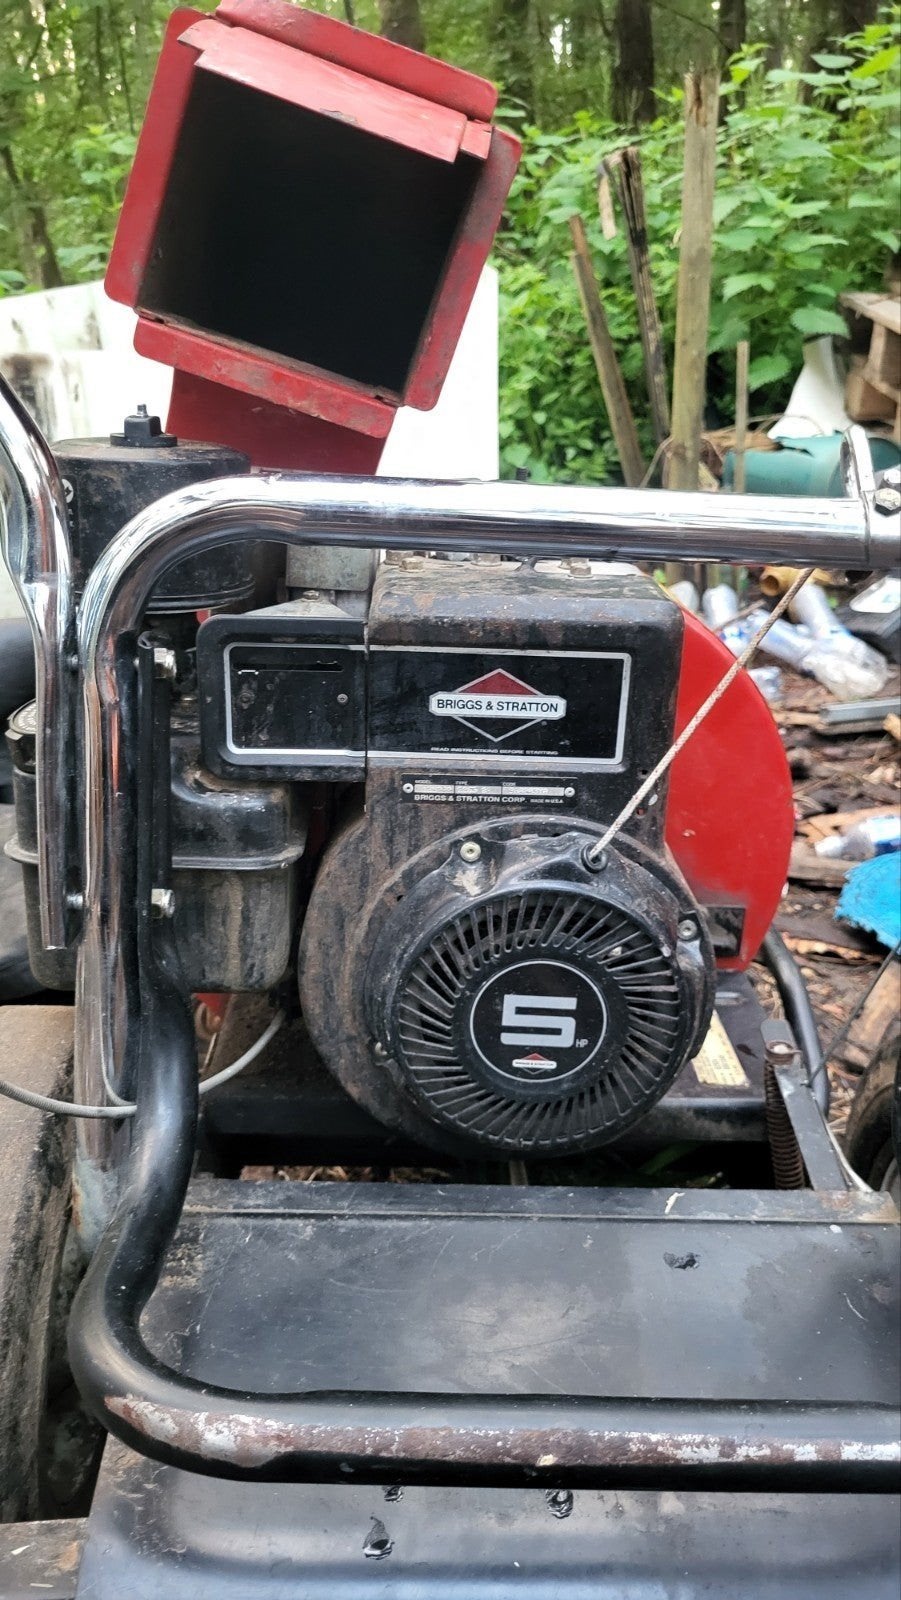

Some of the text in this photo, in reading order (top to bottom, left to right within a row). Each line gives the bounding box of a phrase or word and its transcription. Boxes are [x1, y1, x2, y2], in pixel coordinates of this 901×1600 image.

[436, 699, 559, 713] BRIGGS & STRATTON
[455, 795, 500, 803] STRATTON
[500, 993, 589, 1049] 5 HP
